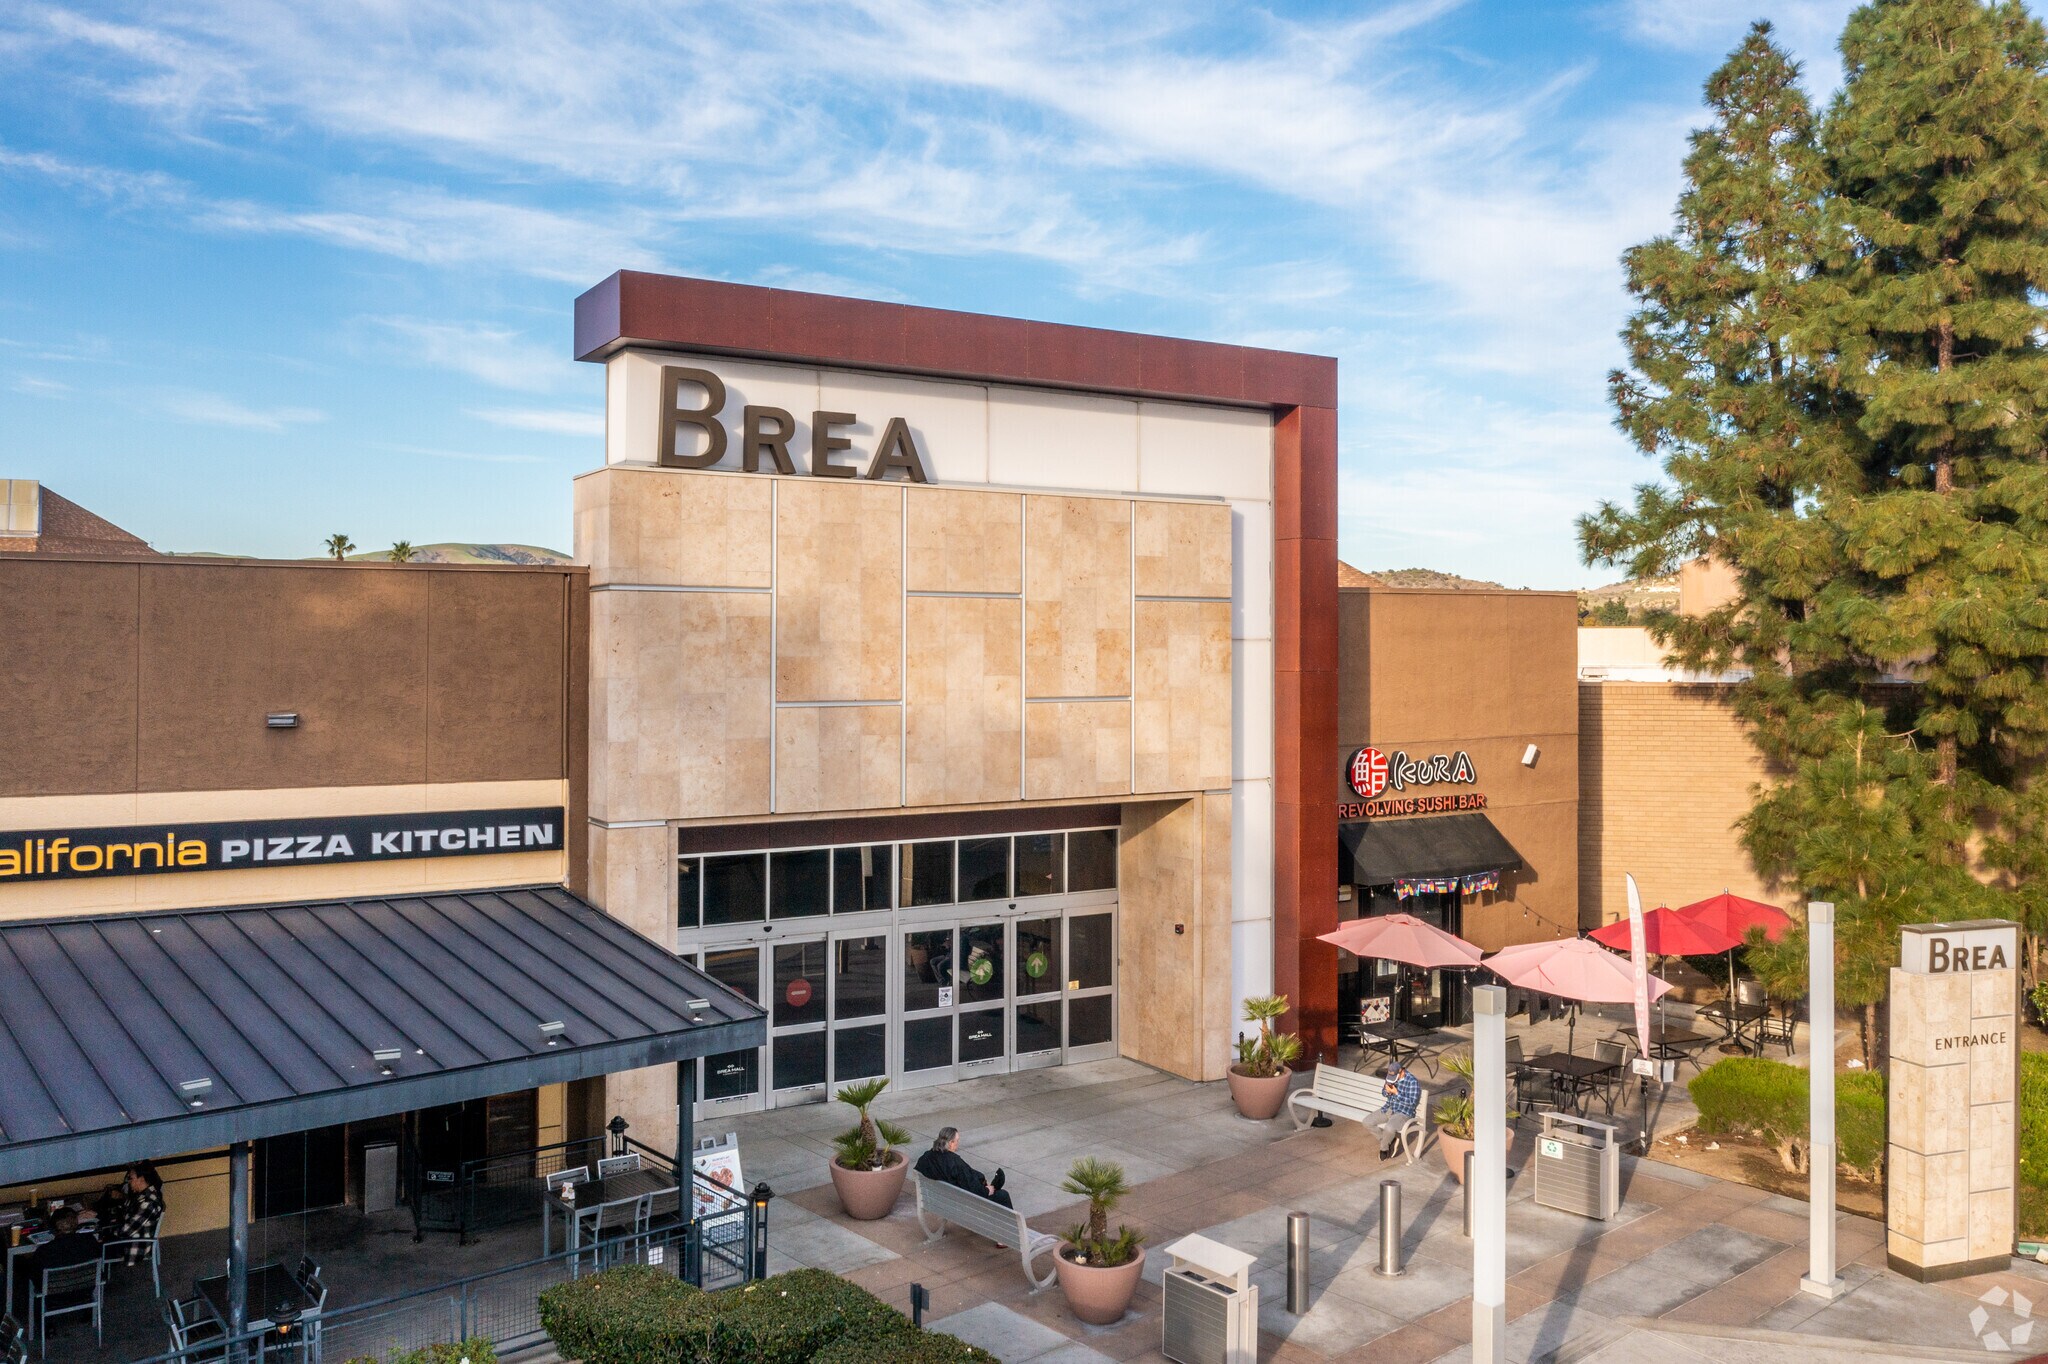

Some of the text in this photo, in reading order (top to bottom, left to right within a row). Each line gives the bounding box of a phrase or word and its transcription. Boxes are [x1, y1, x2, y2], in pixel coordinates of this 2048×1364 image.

[1338, 793, 1486, 819] REVOLVING SUSHI BAR
[221, 835, 354, 863] PIZZA
[371, 823, 553, 854] KITCHEN
[1929, 938, 2008, 973] BREA
[1935, 1031, 2007, 1051] ENTRANCE
